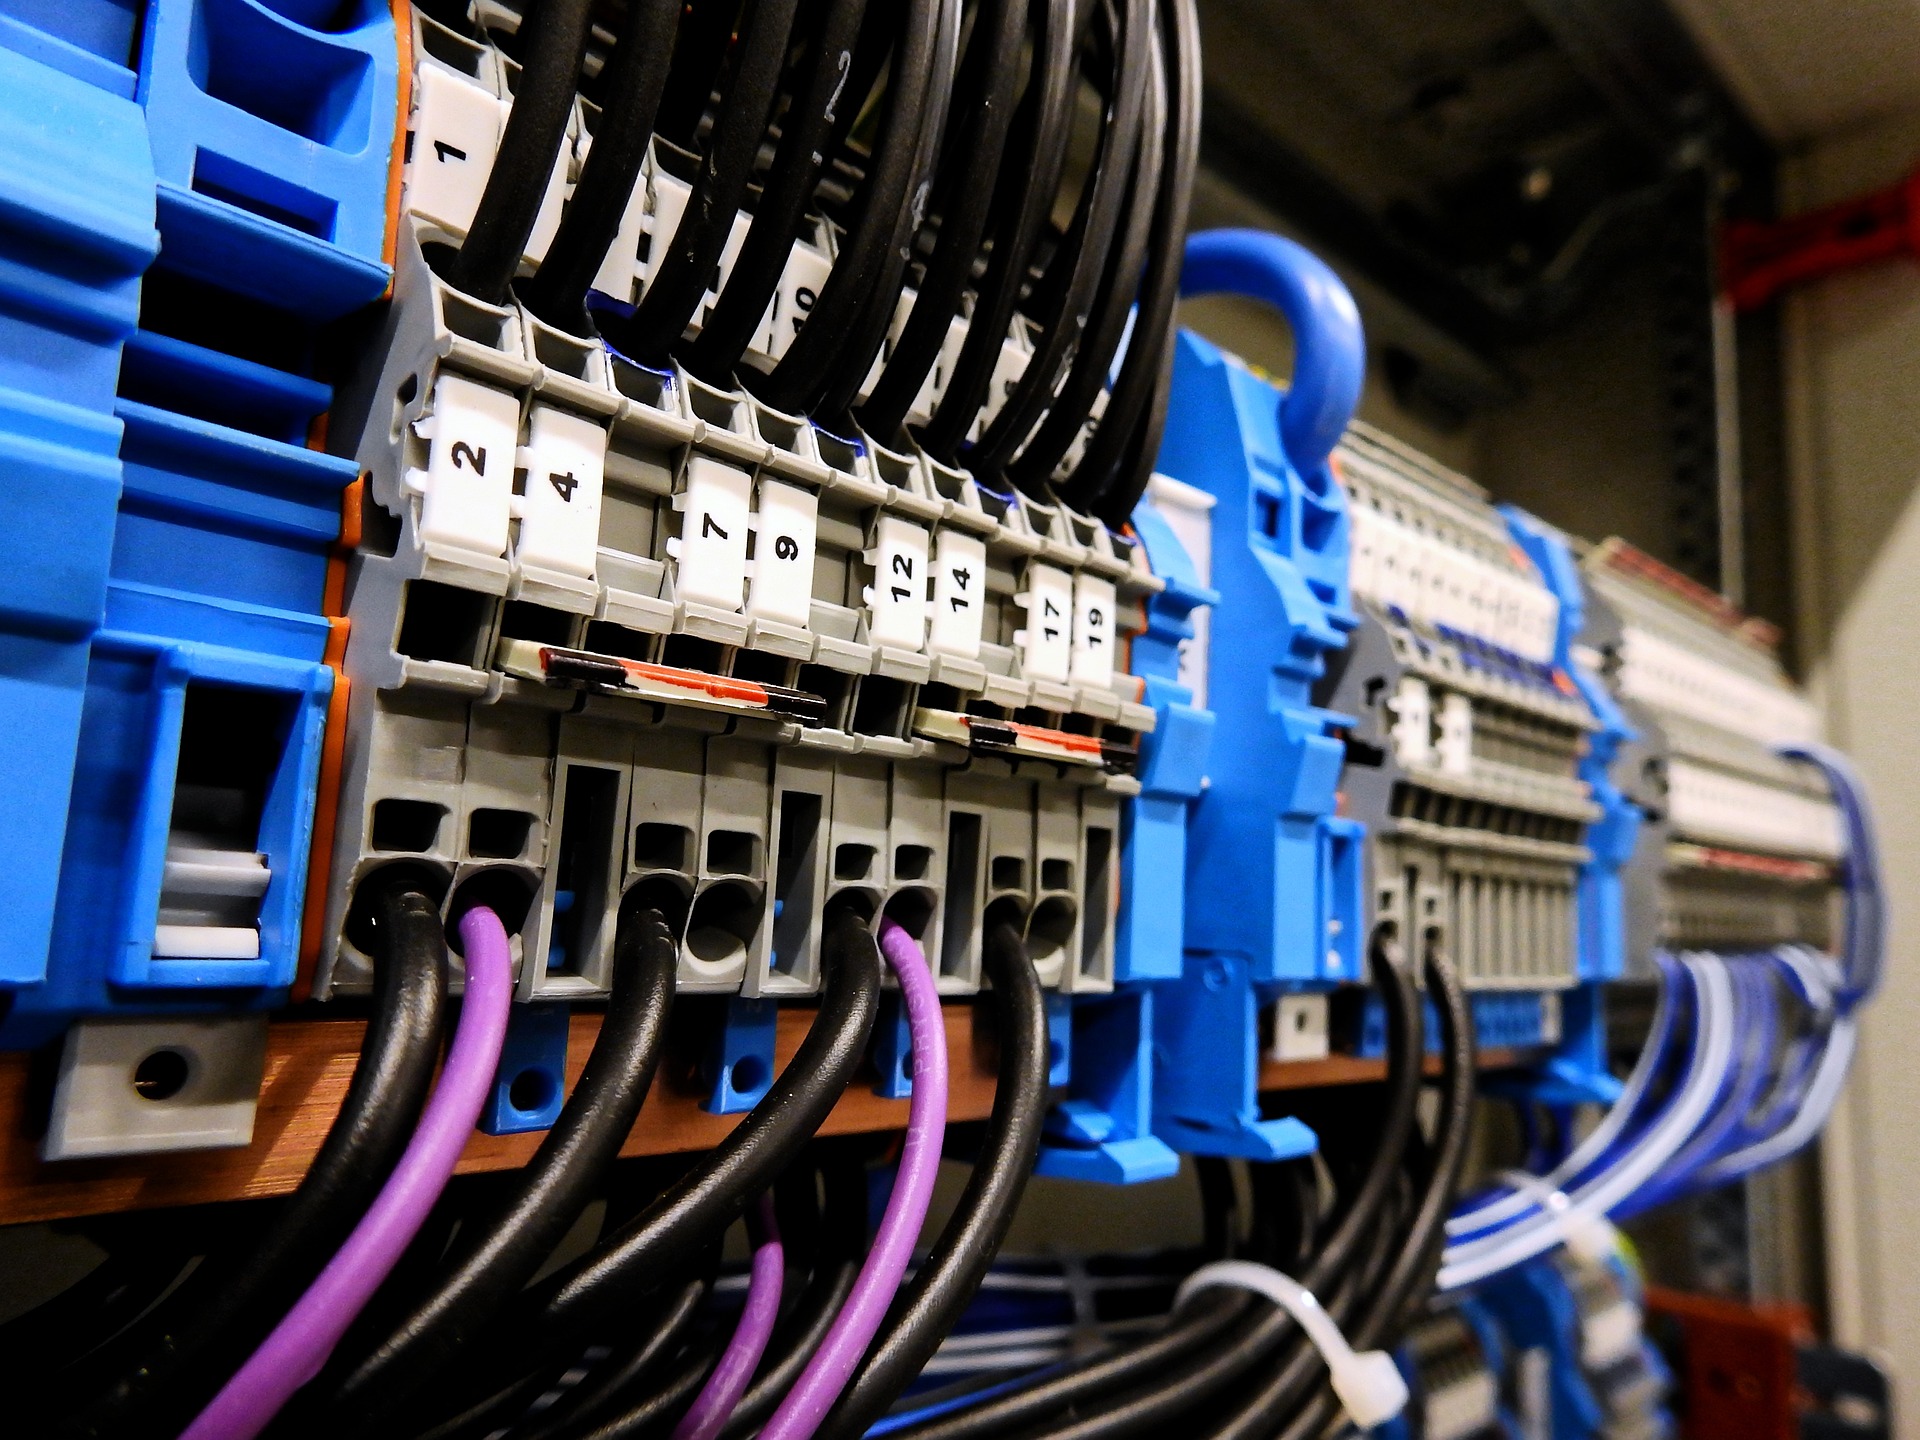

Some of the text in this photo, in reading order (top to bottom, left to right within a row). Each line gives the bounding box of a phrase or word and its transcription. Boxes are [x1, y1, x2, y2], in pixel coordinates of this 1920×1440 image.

[433, 139, 467, 163] 1
[451, 441, 487, 477] 2
[549, 471, 578, 503] 4
[702, 512, 728, 540] 7
[775, 535, 799, 562] 9
[891, 554, 913, 603] 12
[951, 567, 971, 613] 14
[1044, 598, 1060, 641] 17
[1088, 608, 1104, 649] 19
